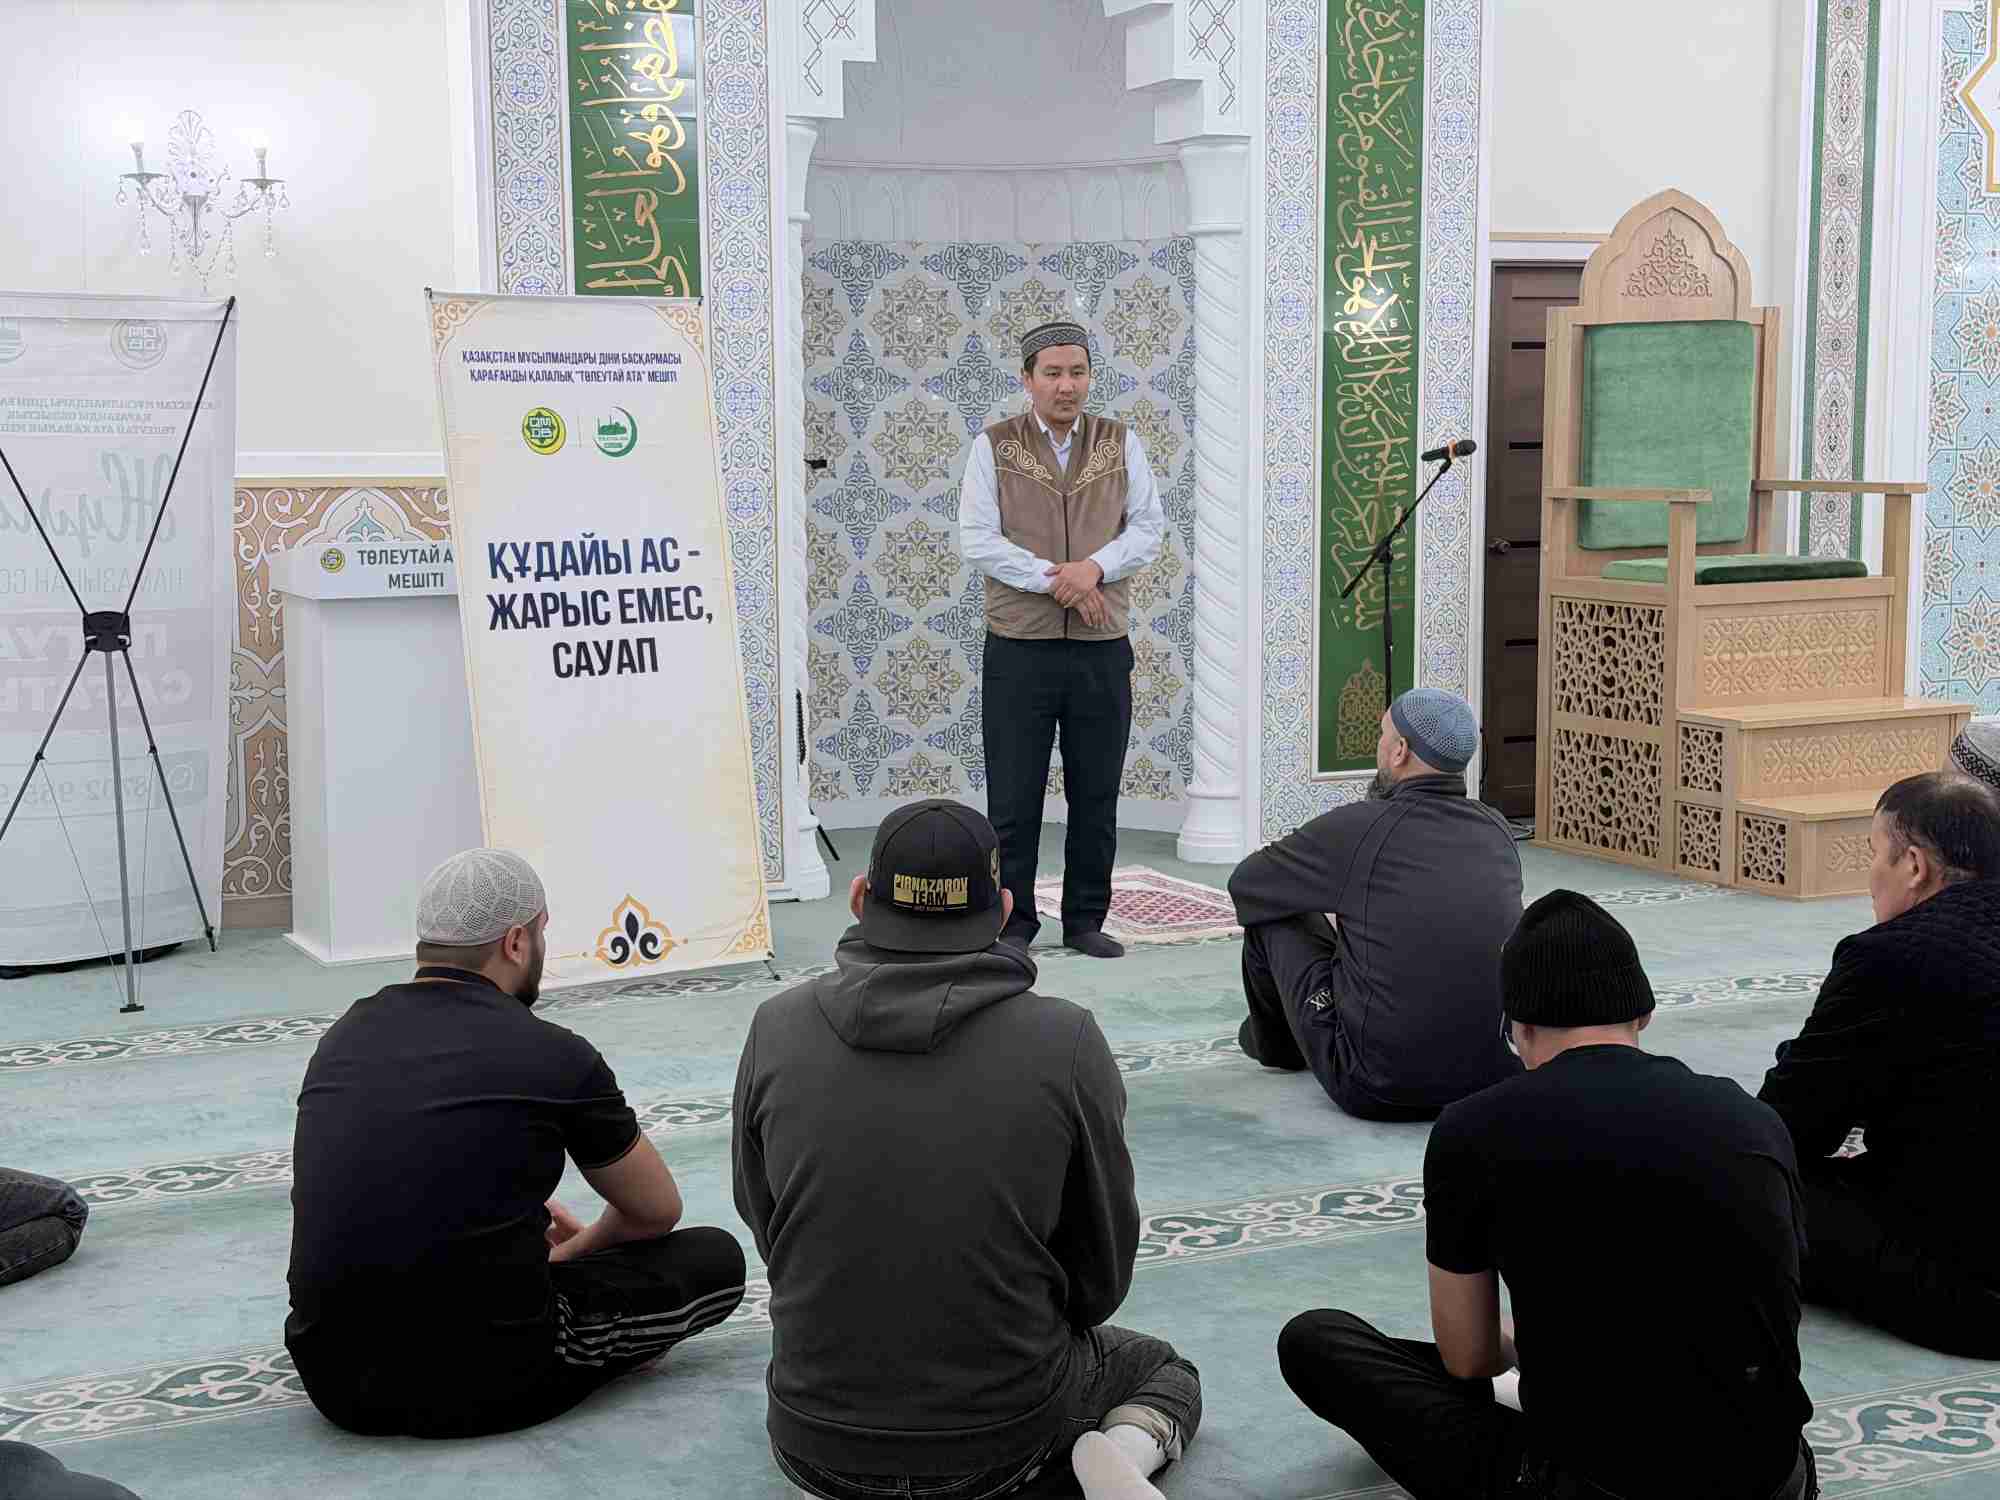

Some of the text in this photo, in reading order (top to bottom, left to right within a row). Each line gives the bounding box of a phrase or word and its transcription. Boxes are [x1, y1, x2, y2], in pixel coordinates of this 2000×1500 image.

[462, 350, 515, 364] ҚАЗАҚСТАН
[357, 544, 440, 566] ТӨЛЕУТАЙ
[487, 532, 632, 583] ҚҰДАЙЫ
[640, 536, 681, 574] АС
[388, 572, 445, 589] МЕШІТІ
[487, 584, 714, 631] ЖАРЫС ЕМЕС,
[552, 637, 659, 679] САУАП
[912, 889, 945, 906] TEAM
